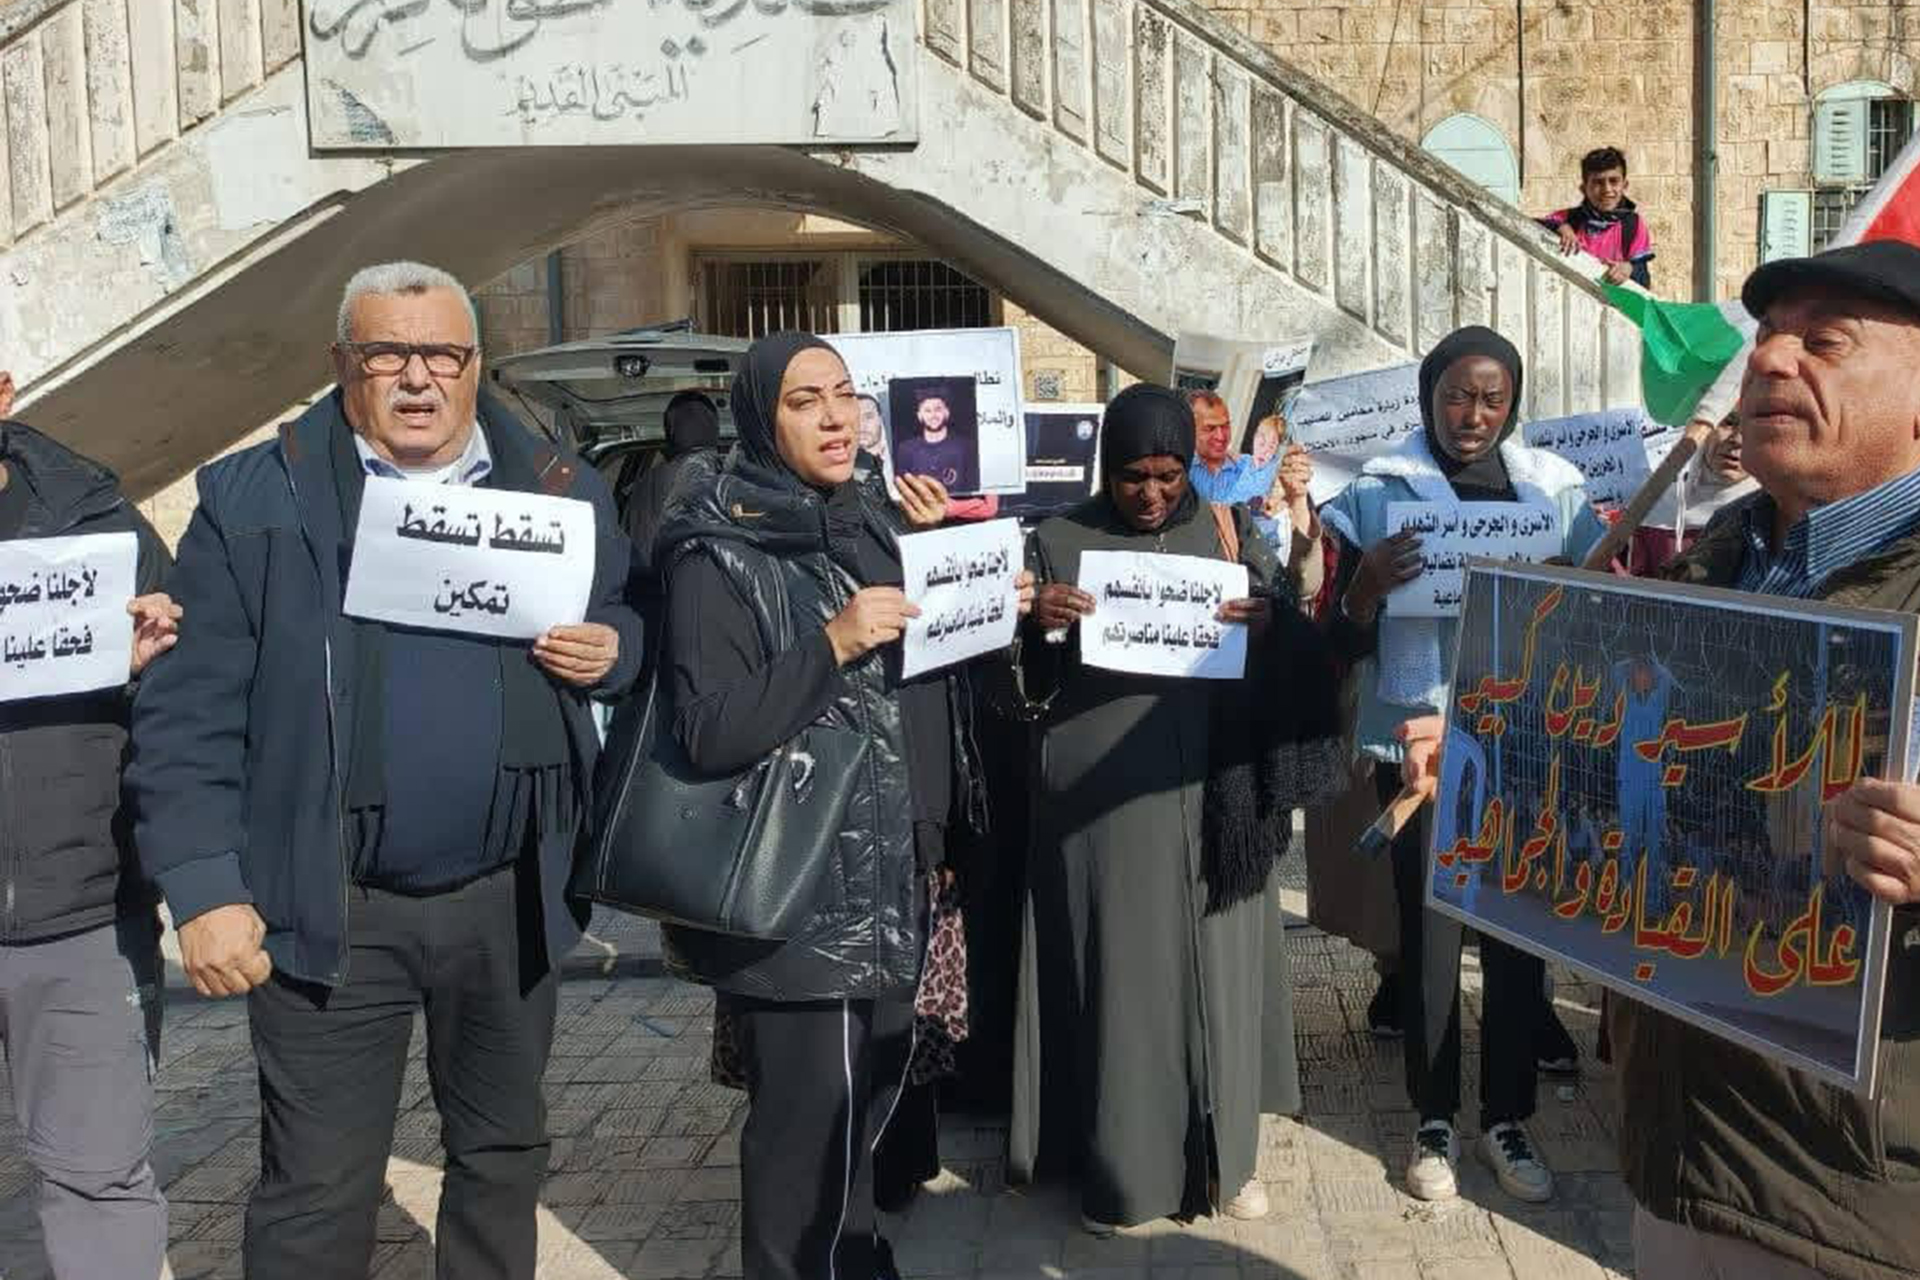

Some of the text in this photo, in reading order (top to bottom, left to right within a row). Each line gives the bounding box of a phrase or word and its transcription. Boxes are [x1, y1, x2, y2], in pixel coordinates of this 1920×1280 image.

[397, 503, 565, 554] تسقط تسقط
[1469, 513, 1509, 539] الجرحى
[1511, 517, 1518, 538] و
[434, 579, 510, 617] تمكين
[1157, 580, 1188, 607] ضحوا
[4, 624, 93, 669] فحقا علينا
[1162, 623, 1190, 651] علينا
[1193, 623, 1220, 649] فحقا
[1633, 670, 1867, 804] للأسير
[1743, 879, 1861, 996] على
